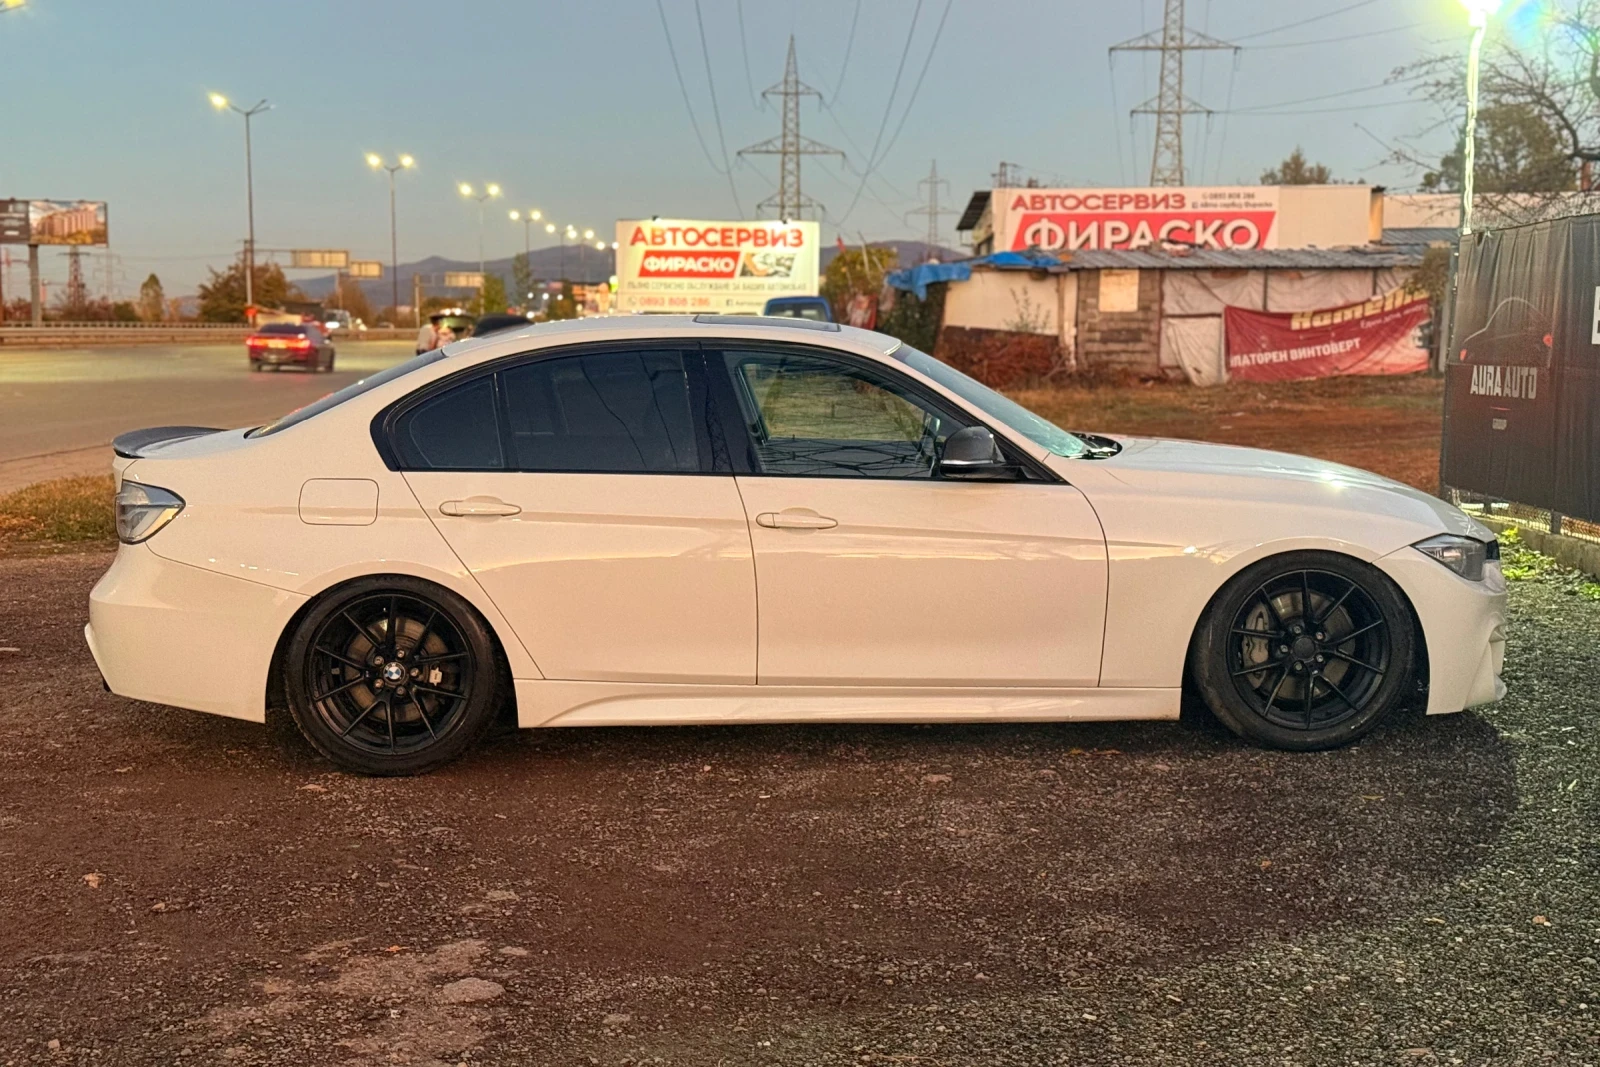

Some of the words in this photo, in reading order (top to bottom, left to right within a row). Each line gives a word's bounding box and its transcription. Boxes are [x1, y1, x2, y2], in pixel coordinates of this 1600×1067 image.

[1011, 193, 1186, 211] АВТОСЕРВИЗ
[630, 226, 804, 248] АВТОСЕРВИЗ
[1024, 217, 1261, 250] ФИРАСКО
[643, 256, 735, 274] ФИРАСКО
[639, 297, 665, 307] 0893
[668, 297, 688, 307] 808
[690, 297, 711, 307] 286
[1289, 337, 1361, 361] ВИНТОВЕРТ
[1469, 364, 1502, 397] AURA
[1502, 365, 1538, 400] AUTO
